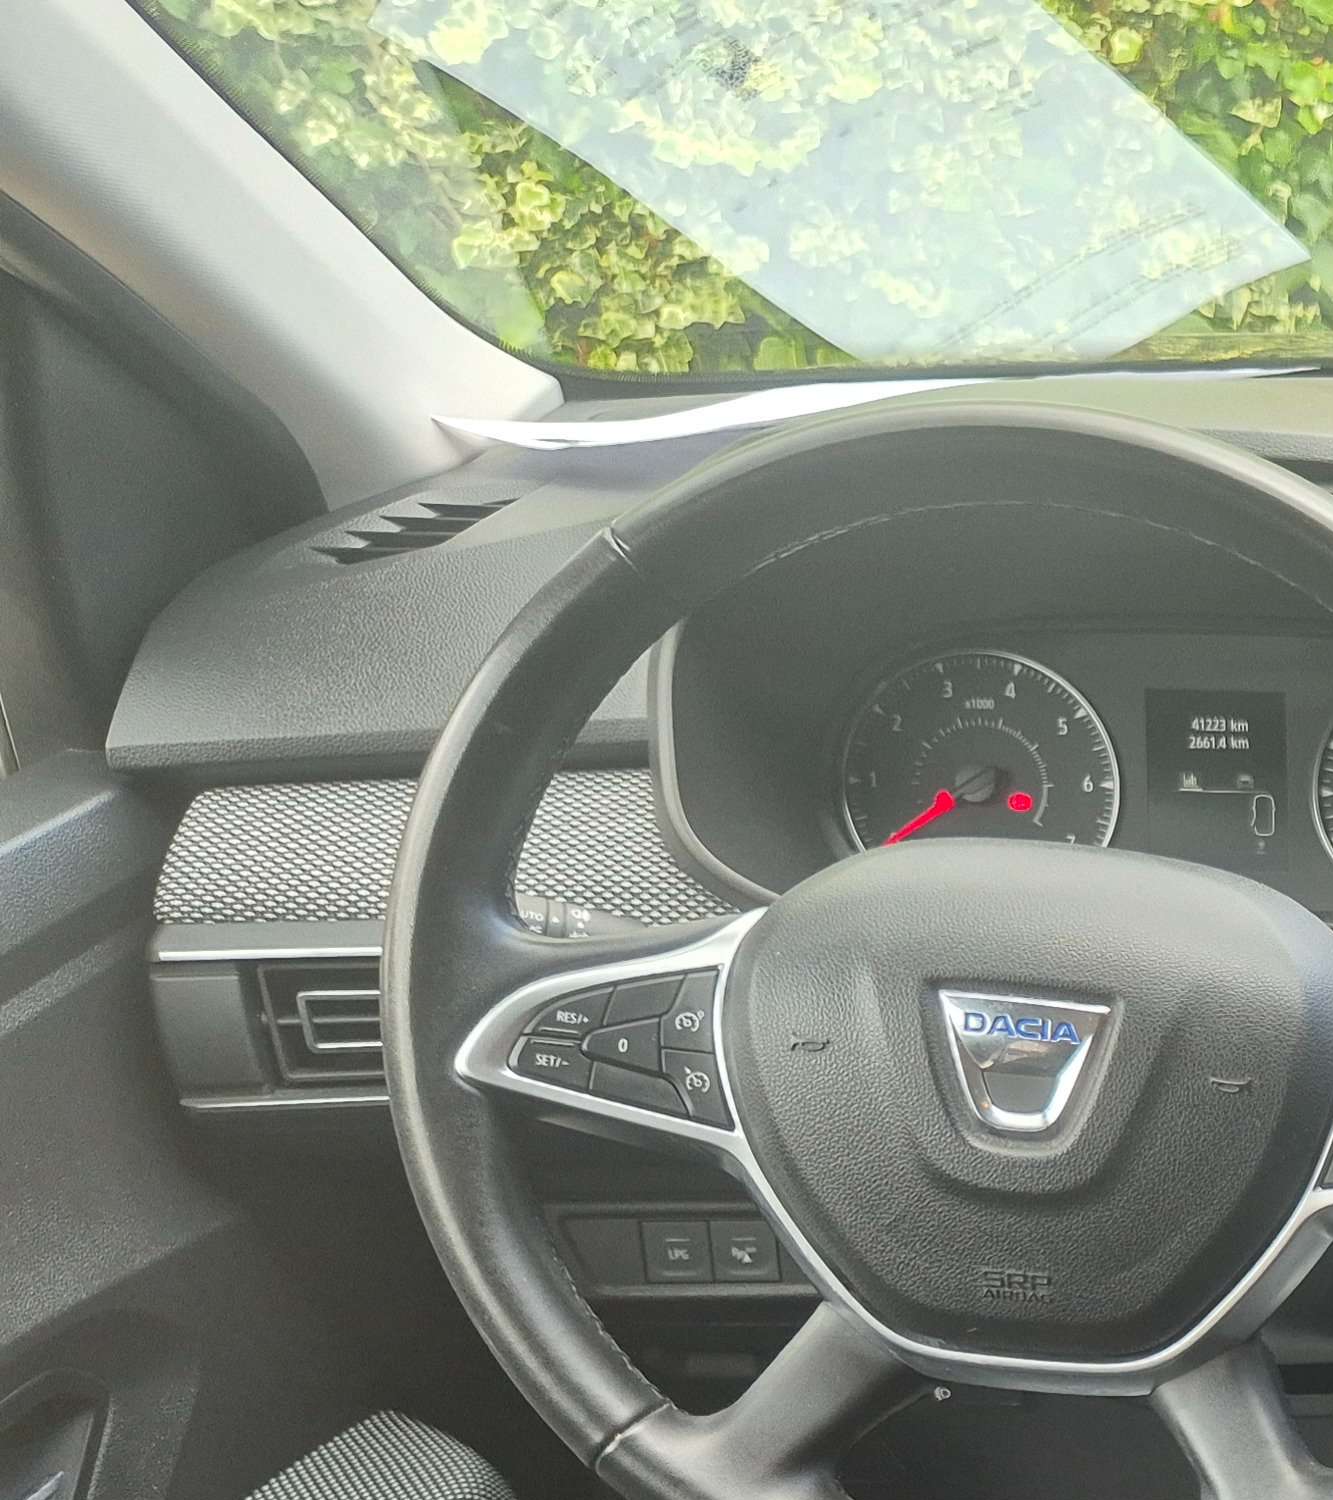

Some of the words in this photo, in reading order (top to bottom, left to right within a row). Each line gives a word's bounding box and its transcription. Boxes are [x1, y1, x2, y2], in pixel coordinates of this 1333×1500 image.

[943, 682, 953, 698] 3
[1005, 683, 1016, 698] 4
[893, 716, 902, 732] 2
[1057, 719, 1068, 735] 5
[1191, 717, 1226, 732] 41223
[1230, 718, 1249, 732] km
[1189, 736, 1226, 750] 2661.4
[1230, 736, 1250, 750] km
[1082, 775, 1094, 792] 6
[961, 1009, 1080, 1044] DACIA
[618, 1038, 629, 1053] 0
